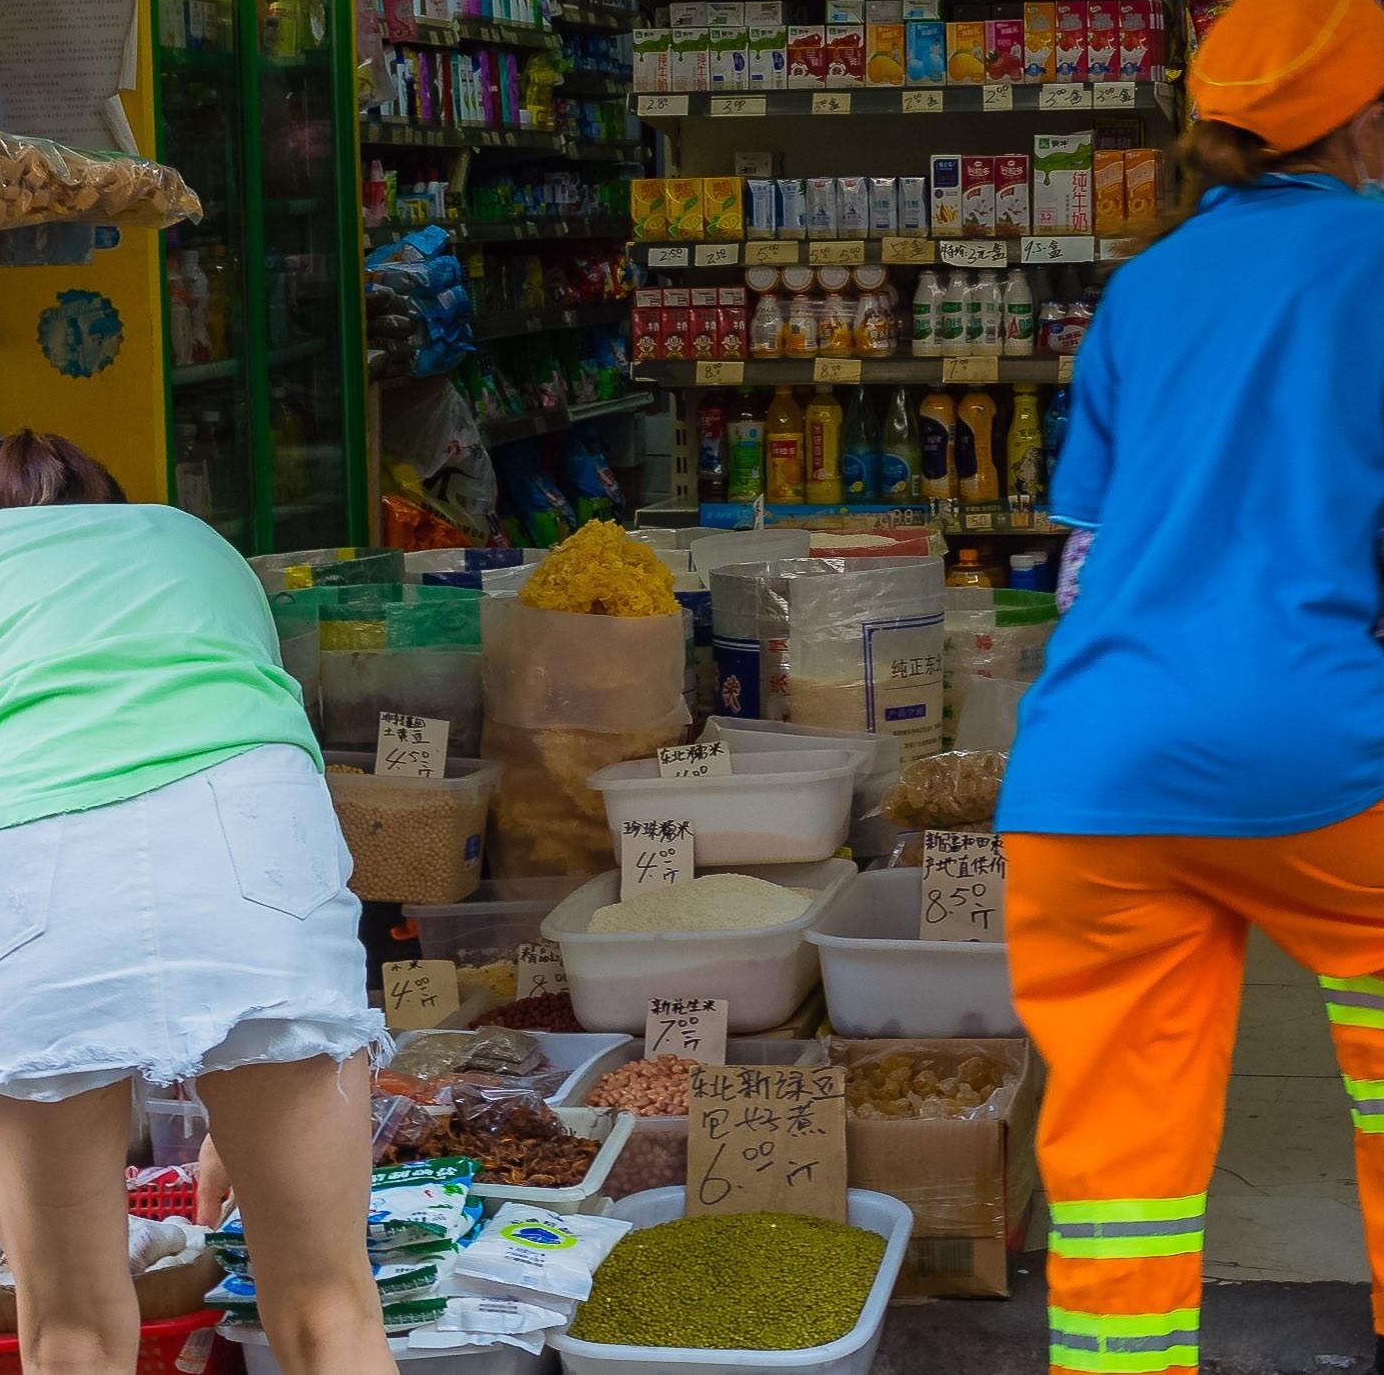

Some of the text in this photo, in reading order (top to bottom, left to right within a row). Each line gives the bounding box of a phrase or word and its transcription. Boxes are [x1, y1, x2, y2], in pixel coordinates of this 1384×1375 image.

[1073, 171, 1090, 233] 纯牛奶
[689, 1068, 845, 1102] 东北新绿豆
